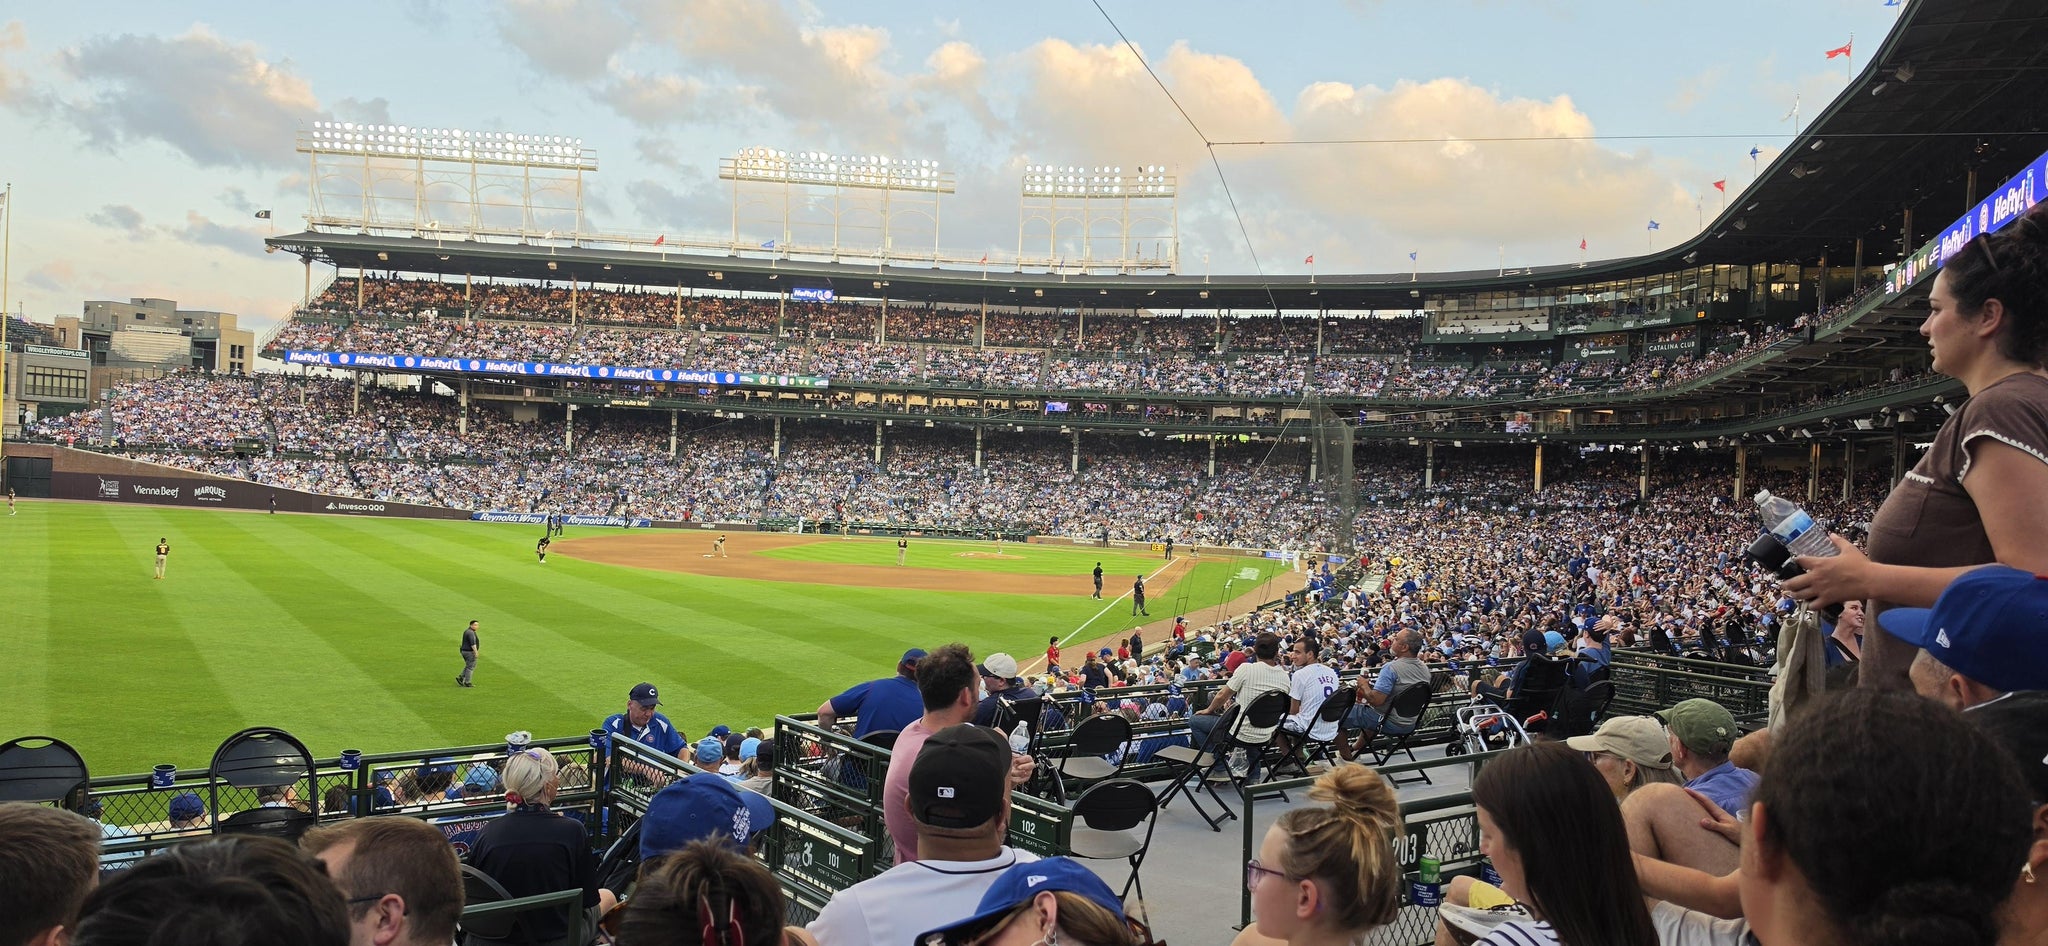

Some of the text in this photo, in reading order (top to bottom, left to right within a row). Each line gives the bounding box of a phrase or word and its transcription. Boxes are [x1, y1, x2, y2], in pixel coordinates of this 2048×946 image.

[1992, 178, 2026, 225] Hefty!
[1941, 222, 1966, 261] Hefty!
[794, 289, 818, 298] Hefty!
[27, 345, 87, 358] WRIGLEYROOFTOPS.COM
[1648, 341, 1695, 352] CATALINA CLUB
[289, 352, 321, 364] Hefty!
[355, 355, 386, 367] Hefty!
[420, 358, 452, 370] Hefty!
[485, 362, 517, 374] Hefty!
[550, 364, 581, 377] Hefty!
[614, 368, 645, 380] Hefty!
[677, 371, 709, 384] Hefty!
[133, 484, 180, 499] Vienna Beef
[194, 485, 227, 499] MARQUEE
[338, 502, 385, 512] Invesco QQQ
[479, 512, 542, 524] Reynolds Wrap
[566, 514, 606, 526] Reynolds
[648, 688, 656, 696] C
[1021, 819, 1036, 835] 102
[1392, 833, 1417, 866] 203
[828, 852, 840, 869] 101
